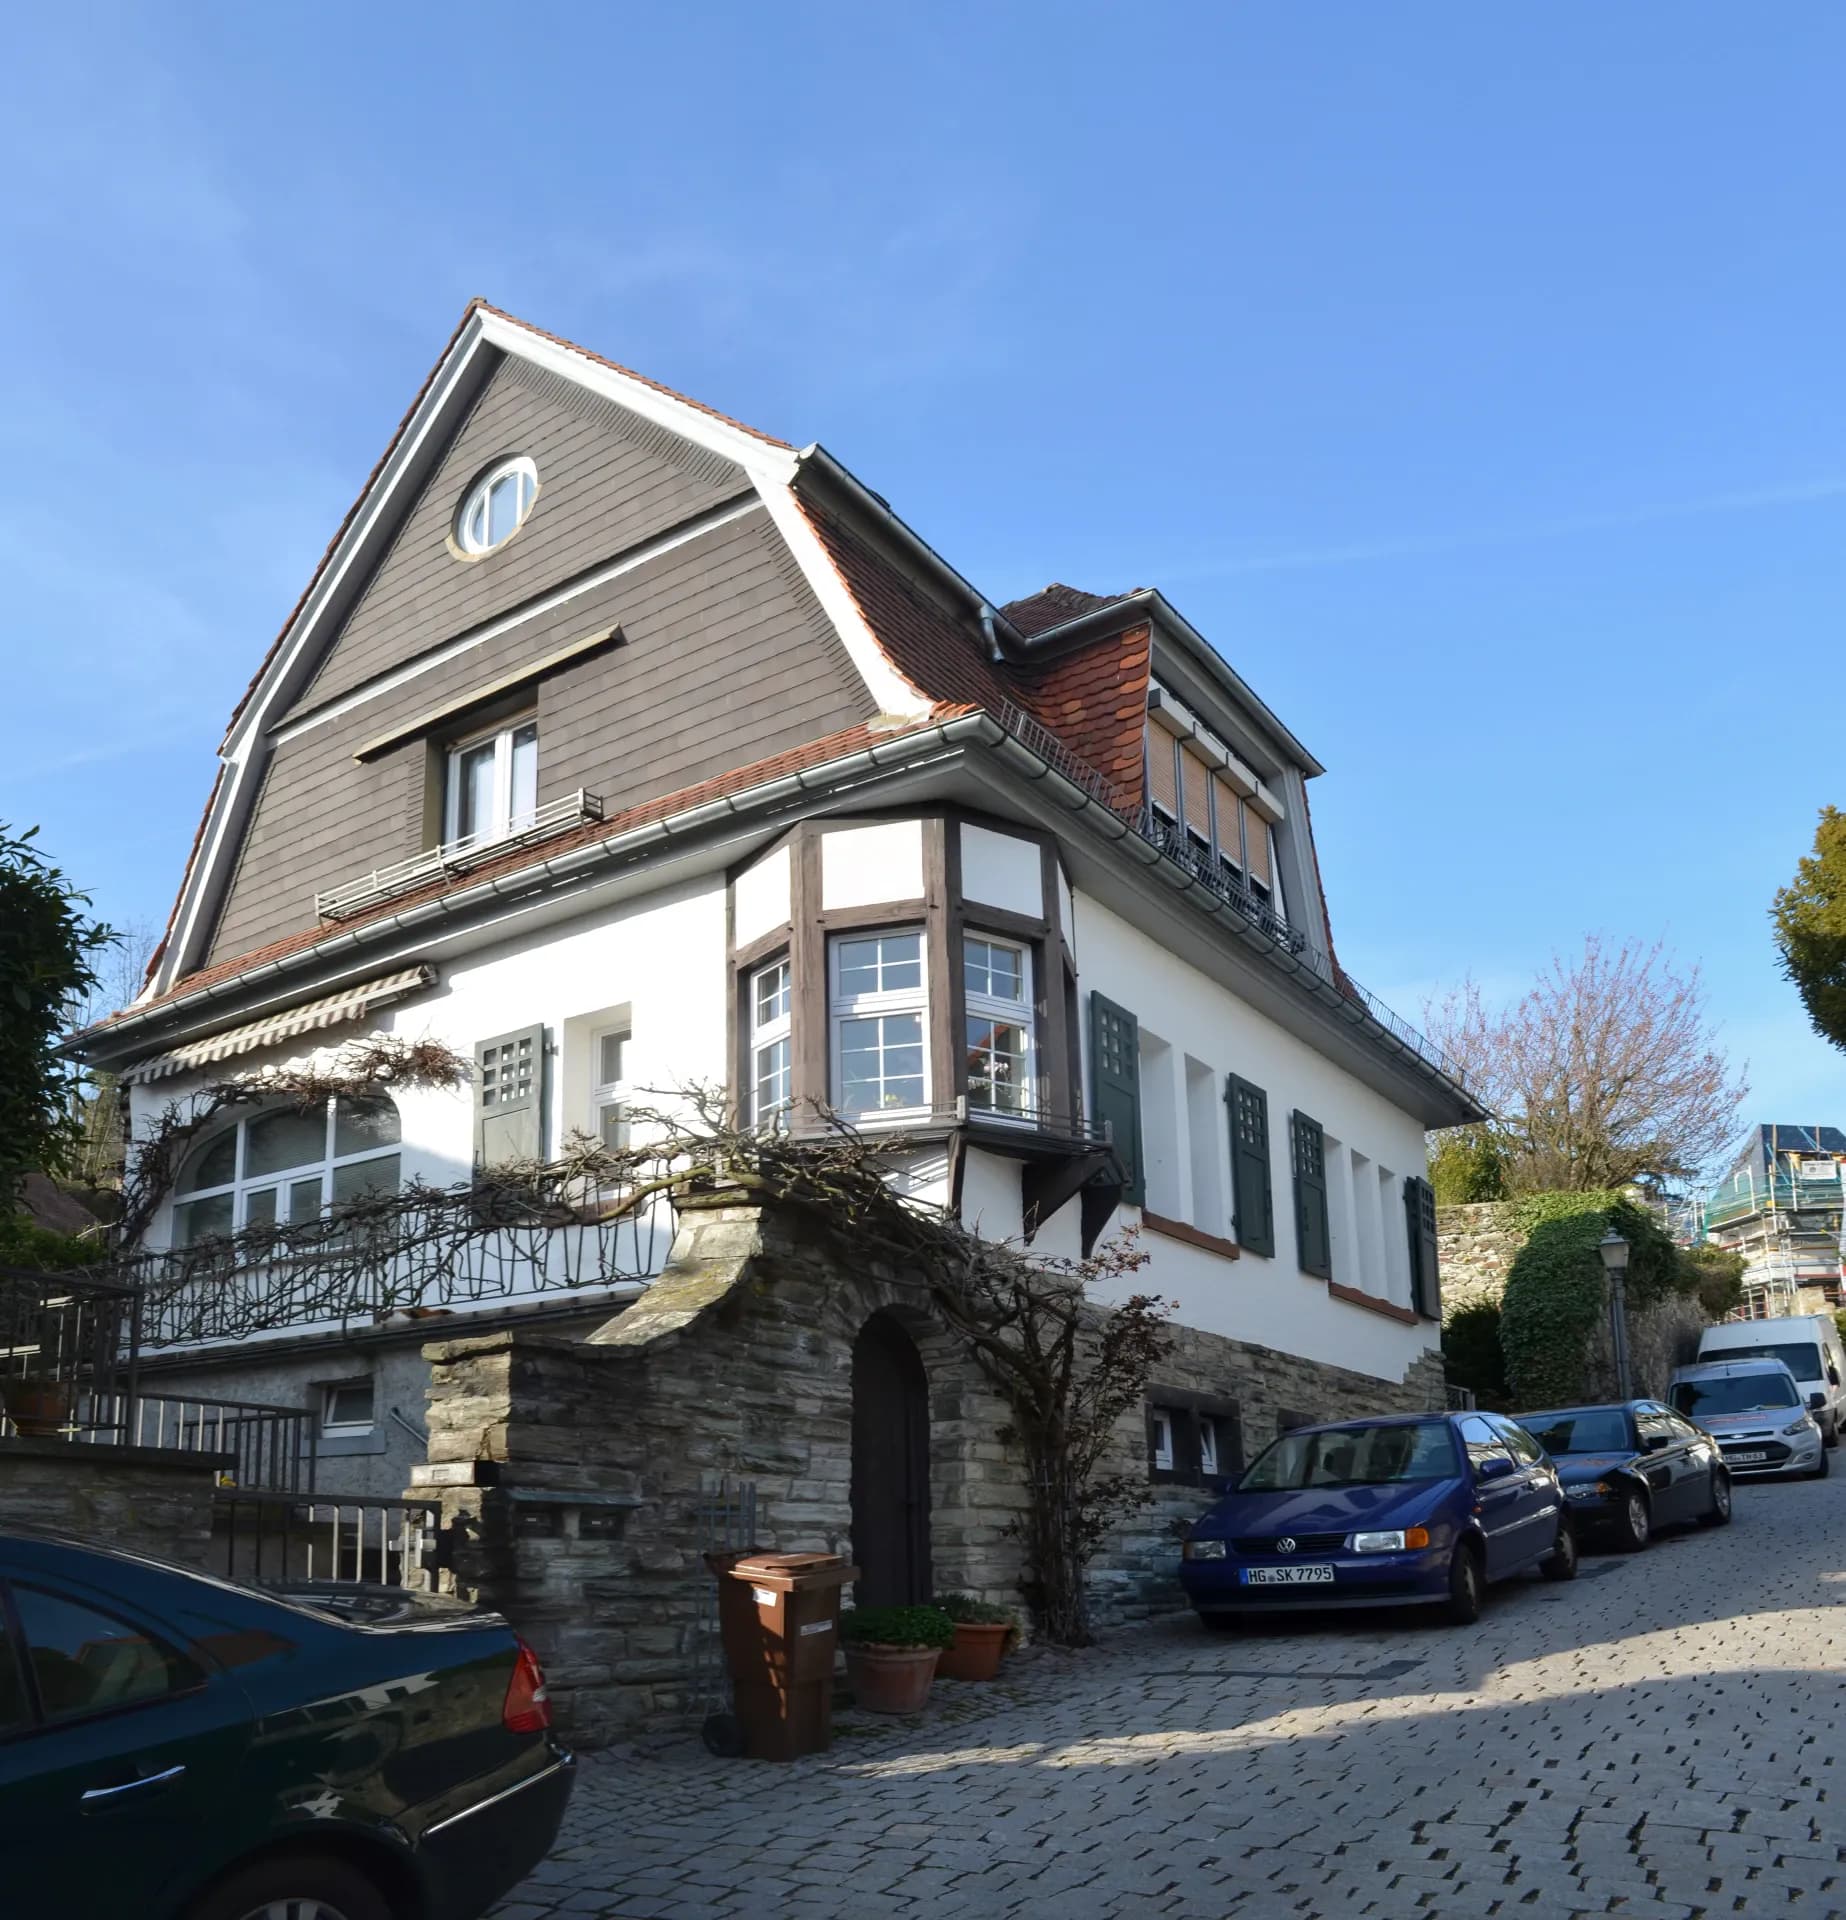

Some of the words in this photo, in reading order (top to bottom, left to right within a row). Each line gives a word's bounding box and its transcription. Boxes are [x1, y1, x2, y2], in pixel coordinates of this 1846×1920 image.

[1277, 1537, 1296, 1554] VW
[1248, 1569, 1266, 1583] HG
[1276, 1568, 1294, 1582] SK
[1296, 1566, 1332, 1581] 7795
